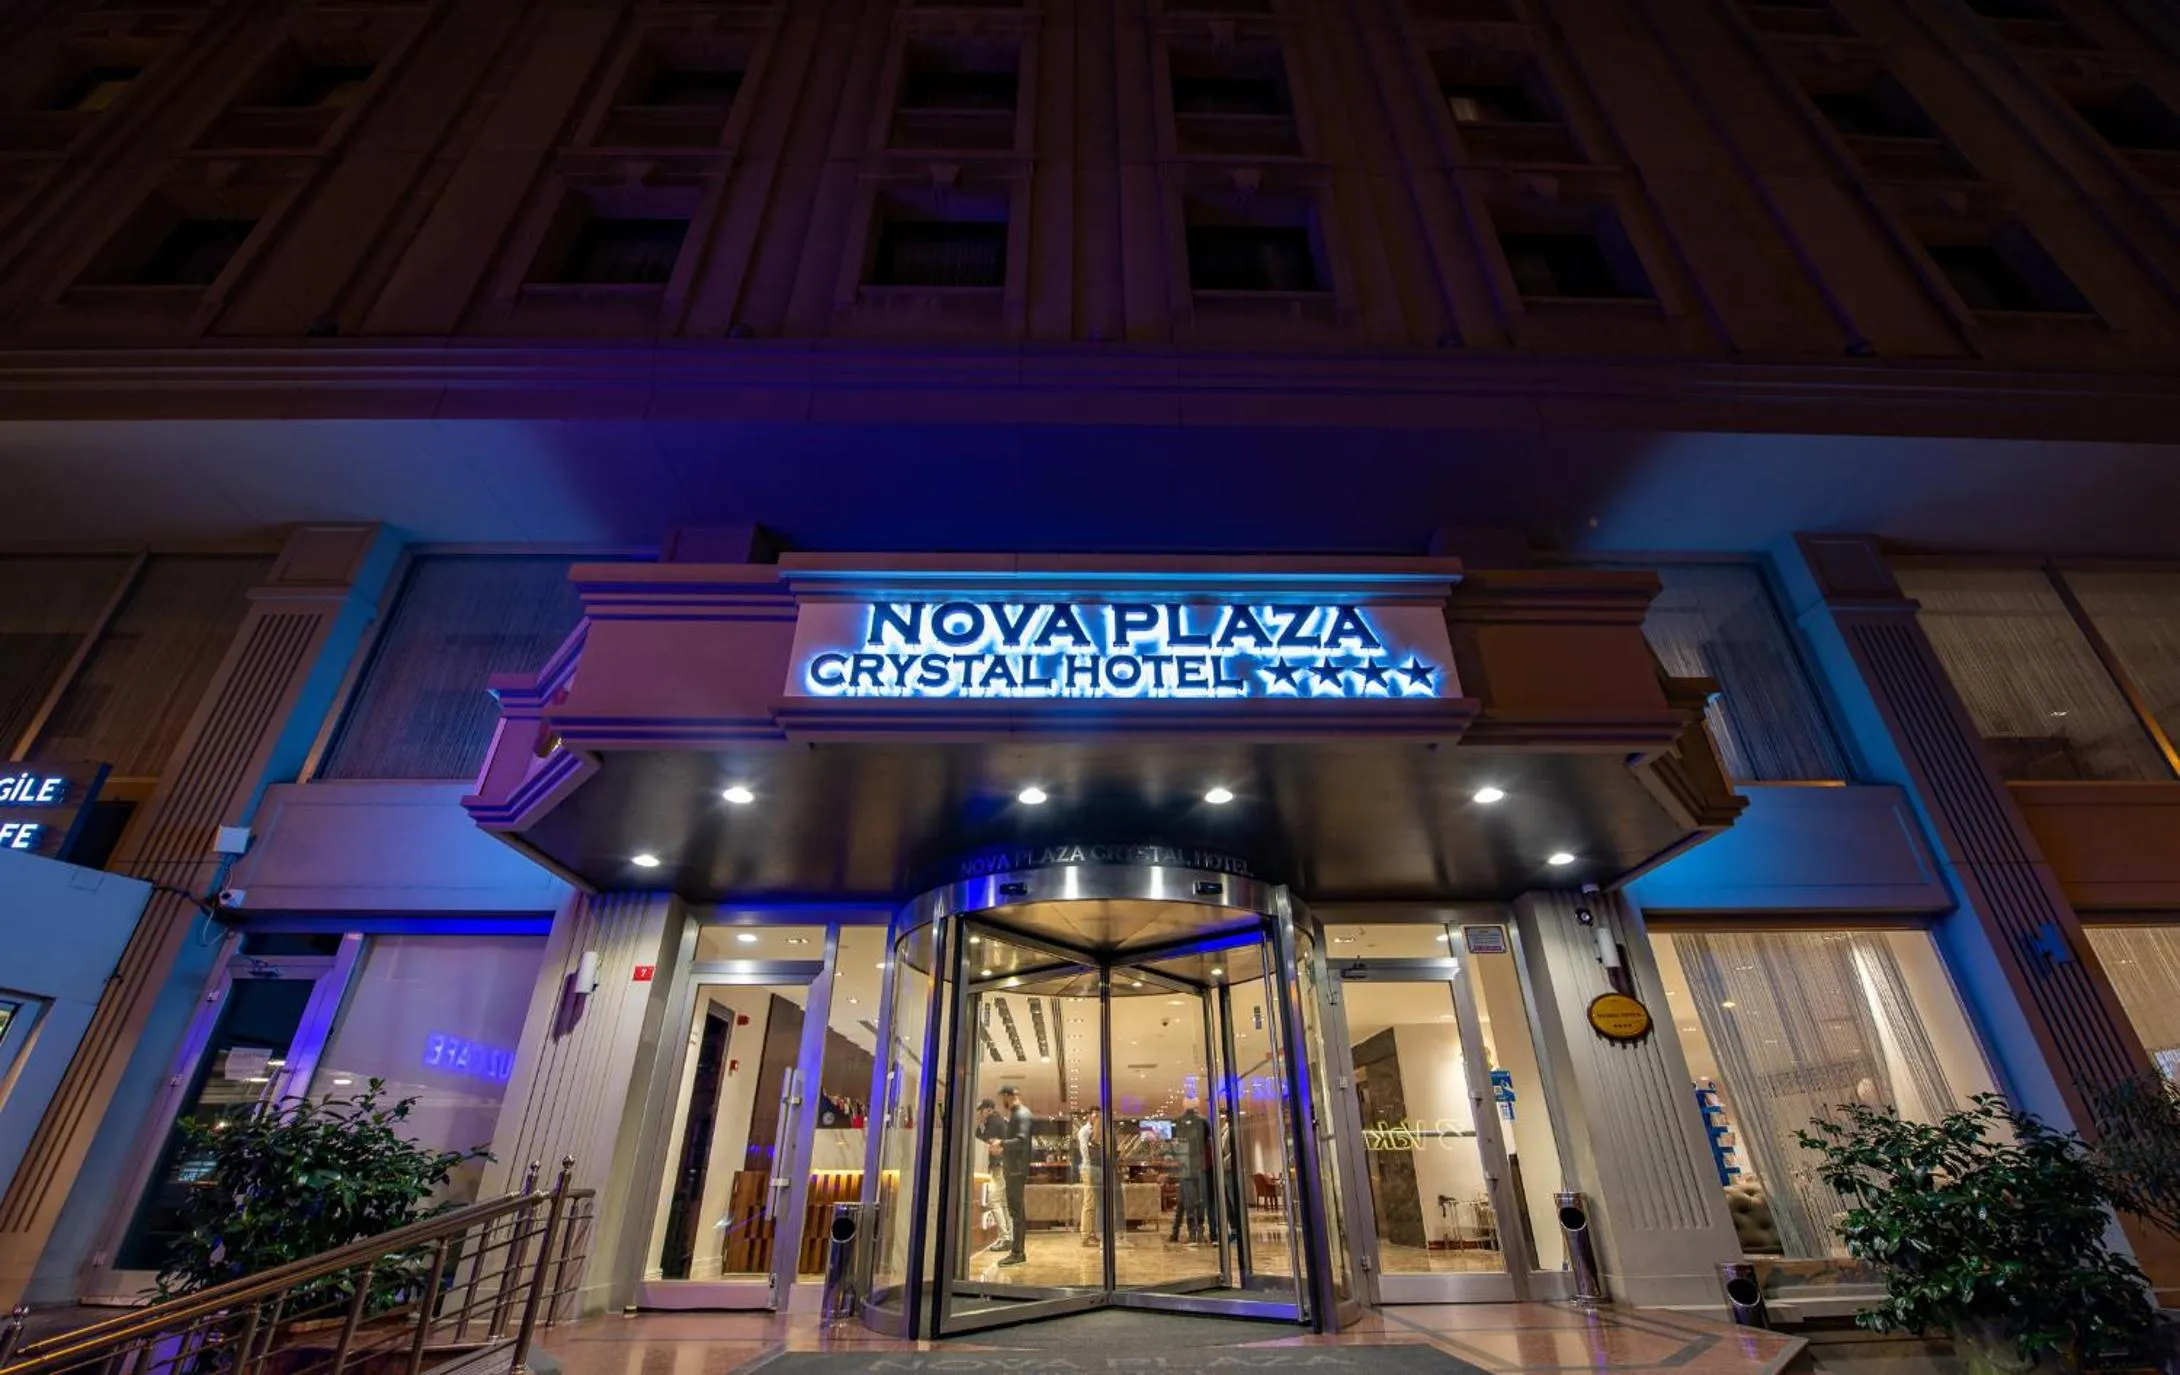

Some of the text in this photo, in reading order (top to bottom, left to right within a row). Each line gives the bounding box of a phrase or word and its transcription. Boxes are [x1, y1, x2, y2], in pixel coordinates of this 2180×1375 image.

[867, 601, 1381, 649] NOVA PLAZA
[809, 653, 1244, 690] CRYSTAL HOTEL
[961, 845, 1253, 877] NOVA PLAZA CRYSTAL HOTEL
